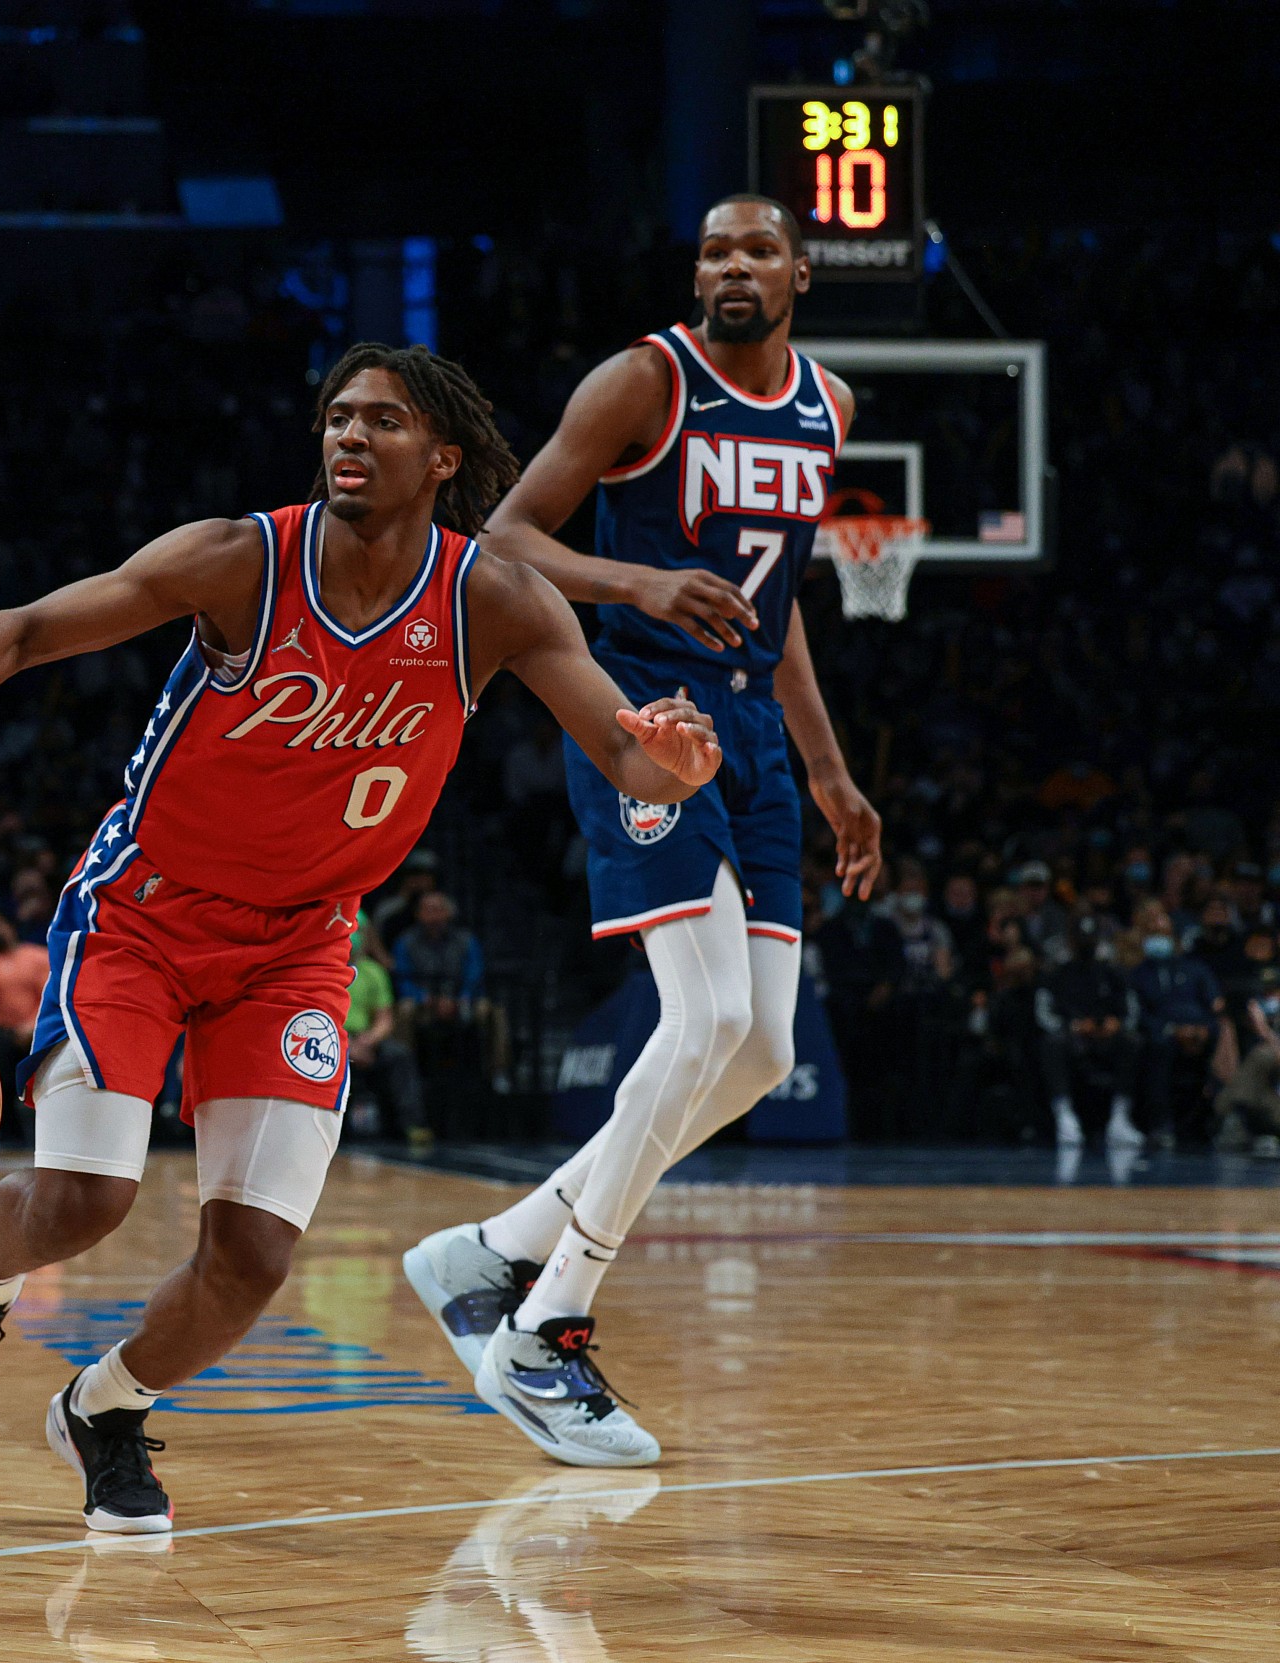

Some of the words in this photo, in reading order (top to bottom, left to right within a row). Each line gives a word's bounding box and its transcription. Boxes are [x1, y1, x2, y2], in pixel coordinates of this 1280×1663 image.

[802, 101, 898, 150] 3:31
[816, 149, 886, 228] 10
[681, 433, 832, 537] NETS
[736, 527, 787, 600] 7
[389, 657, 449, 668] crypto.com
[222, 671, 434, 750] Phila
[342, 766, 409, 830] 0
[289, 1032, 336, 1068] 76ers
